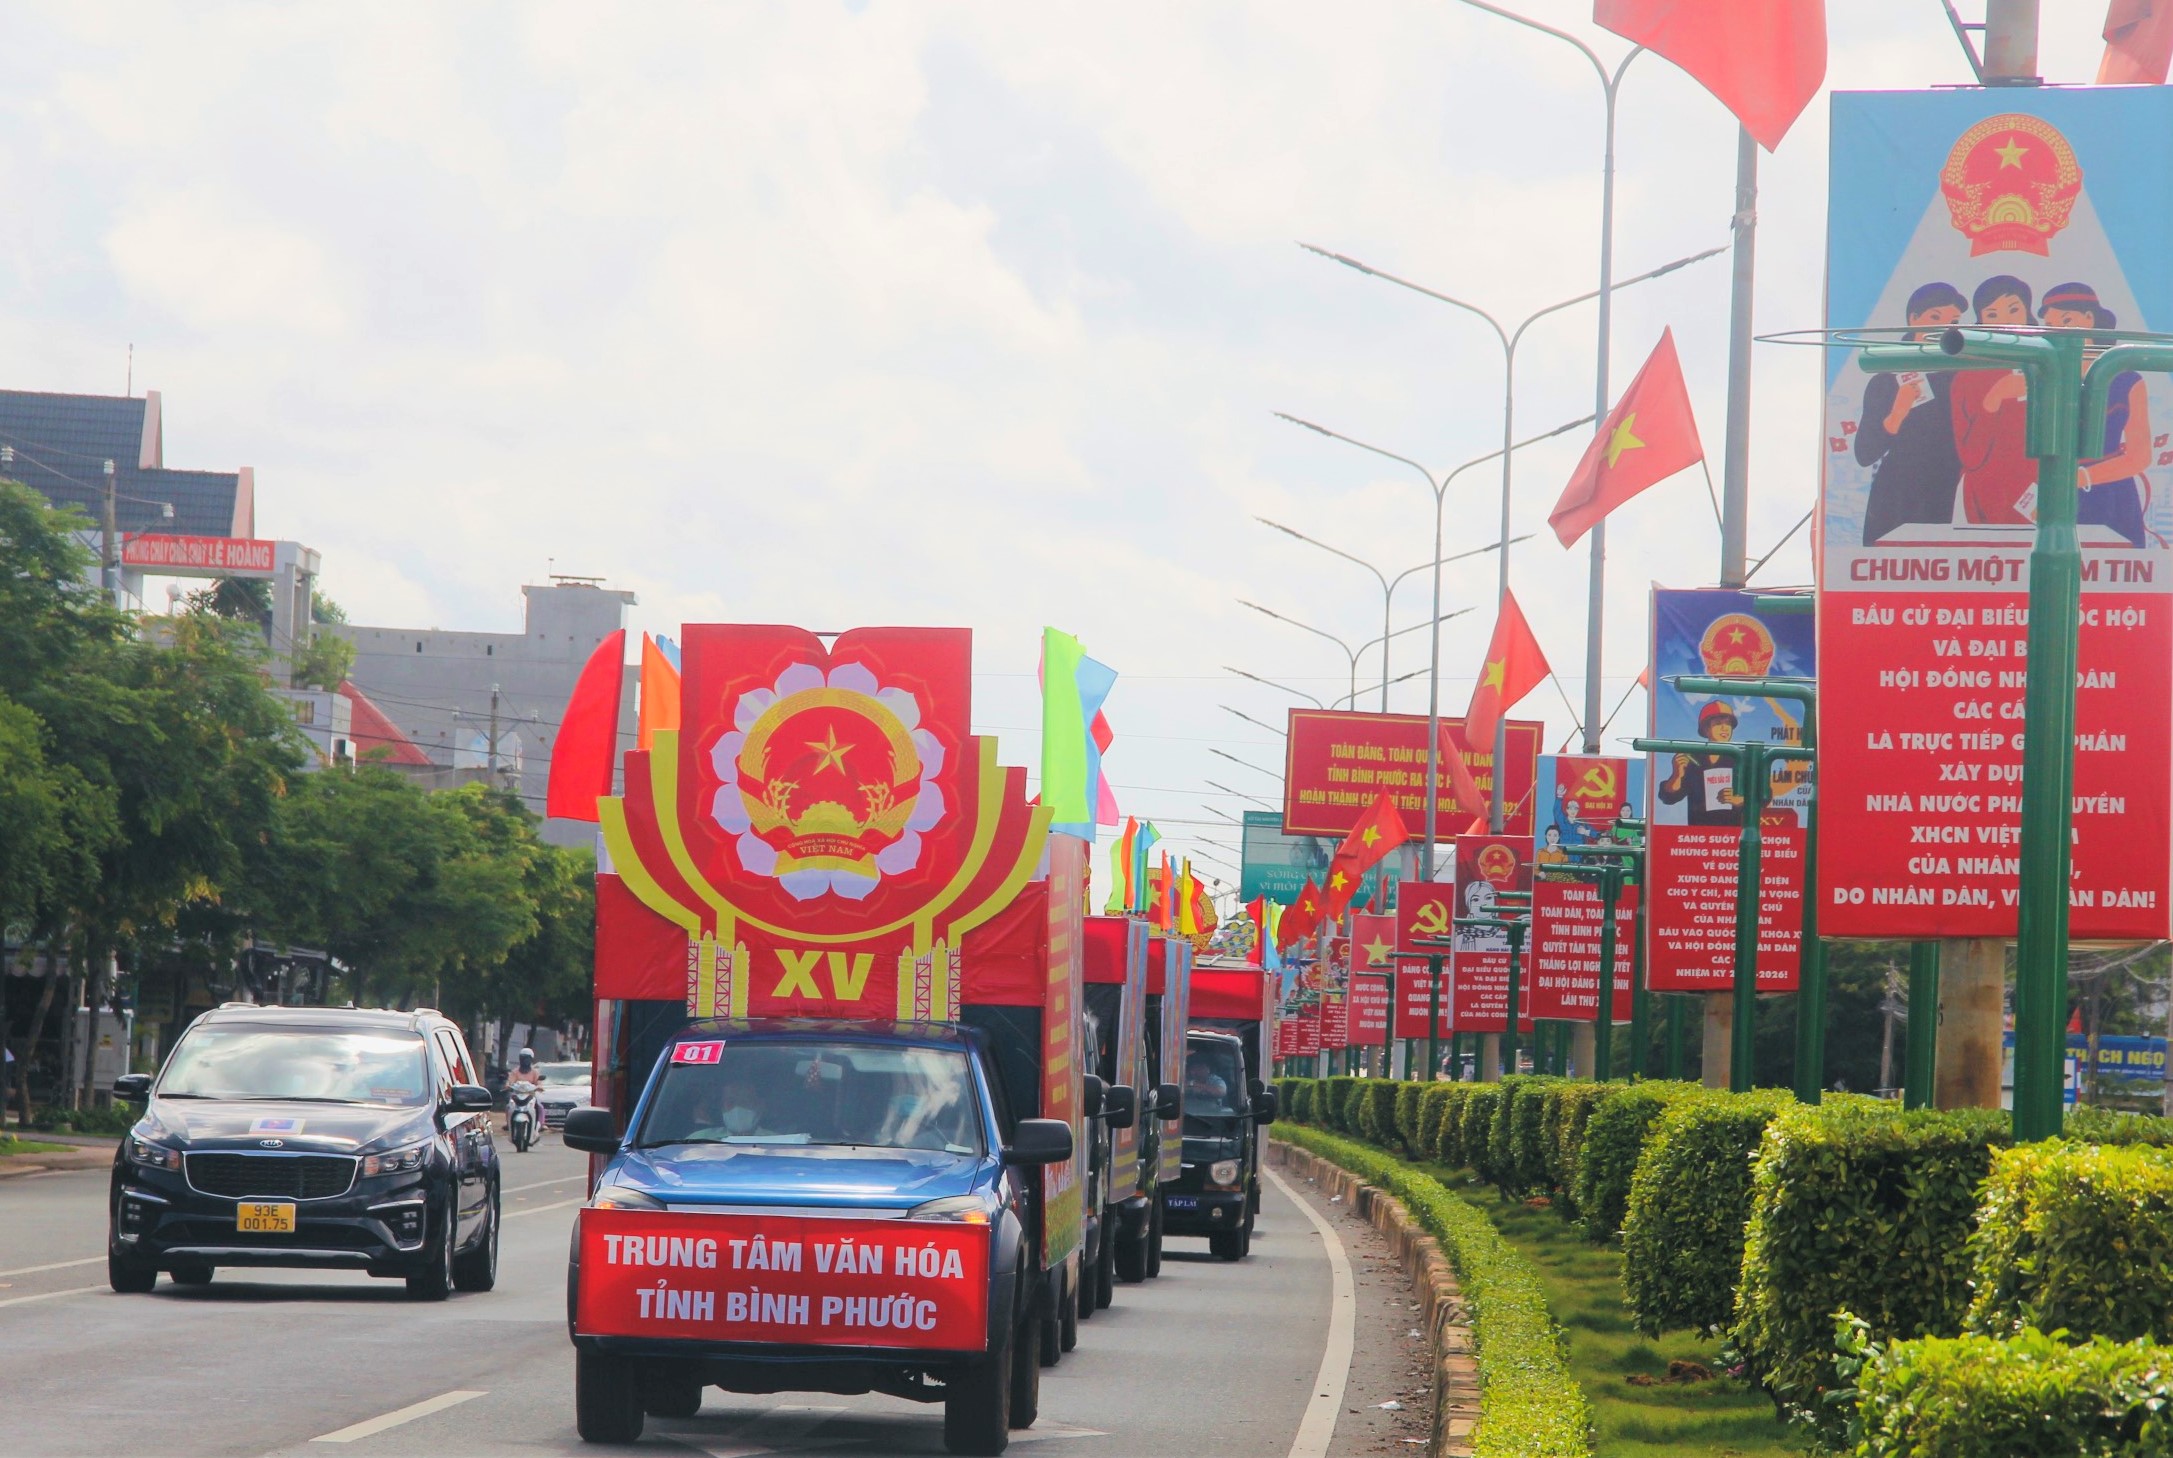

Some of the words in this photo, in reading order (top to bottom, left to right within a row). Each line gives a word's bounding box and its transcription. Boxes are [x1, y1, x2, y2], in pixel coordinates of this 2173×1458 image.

[208, 540, 224, 566] LÊ
[227, 541, 270, 567] HOÀNG
[1850, 558, 1950, 582] CHUNG
[1957, 554, 2025, 585] MỘT
[2105, 559, 2154, 583] TIN
[1852, 602, 1894, 626] BẦU
[1902, 603, 1931, 626] CỬ
[1935, 608, 1974, 630] ĐẠI
[1982, 602, 2029, 626] BIỂU
[2106, 605, 2145, 631] HỘI
[1933, 636, 1962, 657] VÀ
[1968, 640, 2006, 661] ĐẠI
[1880, 667, 1919, 692] HỘI
[1926, 665, 1991, 688] ĐỒNG
[1999, 671, 2027, 688] NH
[1953, 699, 1992, 719] CÁC
[2000, 697, 2026, 719] CẤ
[1867, 728, 1893, 750] LÀ
[1900, 733, 1952, 754] TRỰC
[1959, 728, 2004, 750] TIẾP
[1939, 761, 1981, 781] XÂY
[1866, 791, 1912, 812] NHÀ
[1920, 791, 1980, 812] NƯỚC
[2072, 791, 2126, 814] UYỀN
[1760, 817, 1784, 826] XV
[1910, 826, 1969, 843] XHCN
[1976, 823, 2022, 848] VIỆT
[829, 845, 854, 855] NAM
[1908, 852, 1951, 874] CỦA
[1958, 854, 2020, 875] NHÂN
[1667, 888, 1688, 896] CHO
[1834, 887, 1865, 904] DO
[1872, 884, 1934, 905] NHÂN
[1942, 885, 1994, 909] DÂN,
[2069, 886, 2094, 907] ÂN
[2102, 887, 2156, 909] DÂN!
[1758, 915, 1772, 925] ÂN
[771, 949, 875, 1000] XV
[683, 1045, 712, 1061] 01
[254, 1205, 278, 1216] 93E
[244, 1218, 288, 1230] 001.75
[603, 1235, 717, 1269] TRUNG
[729, 1234, 802, 1272] TÂM
[814, 1237, 883, 1275] VĂN
[895, 1241, 964, 1279] HÓA
[636, 1278, 715, 1321] TỈNH
[726, 1286, 809, 1325] BÌNH
[821, 1288, 937, 1330] PHƯỚC
